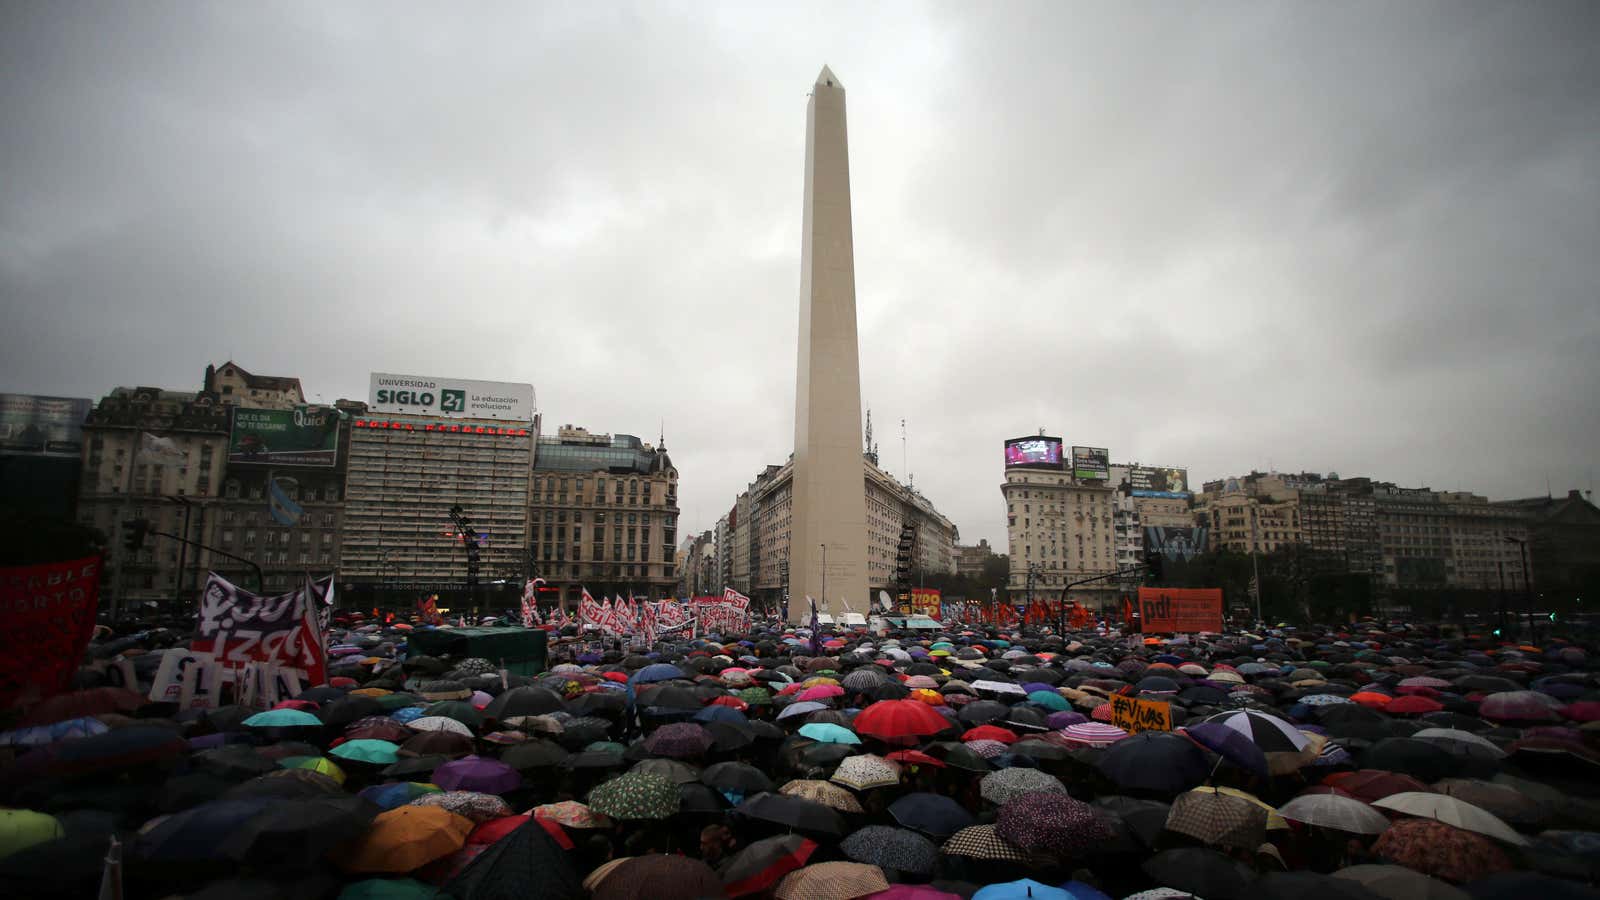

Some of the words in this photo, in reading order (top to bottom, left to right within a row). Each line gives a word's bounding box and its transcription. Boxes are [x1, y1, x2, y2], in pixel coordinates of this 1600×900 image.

[379, 378, 436, 389] UNIVERSIDAD
[377, 390, 435, 406] SIGLO
[443, 392, 463, 411] 21
[471, 402, 512, 410] evoluciona
[481, 395, 518, 404] educación
[293, 409, 327, 427] Quick
[725, 591, 747, 608] MST
